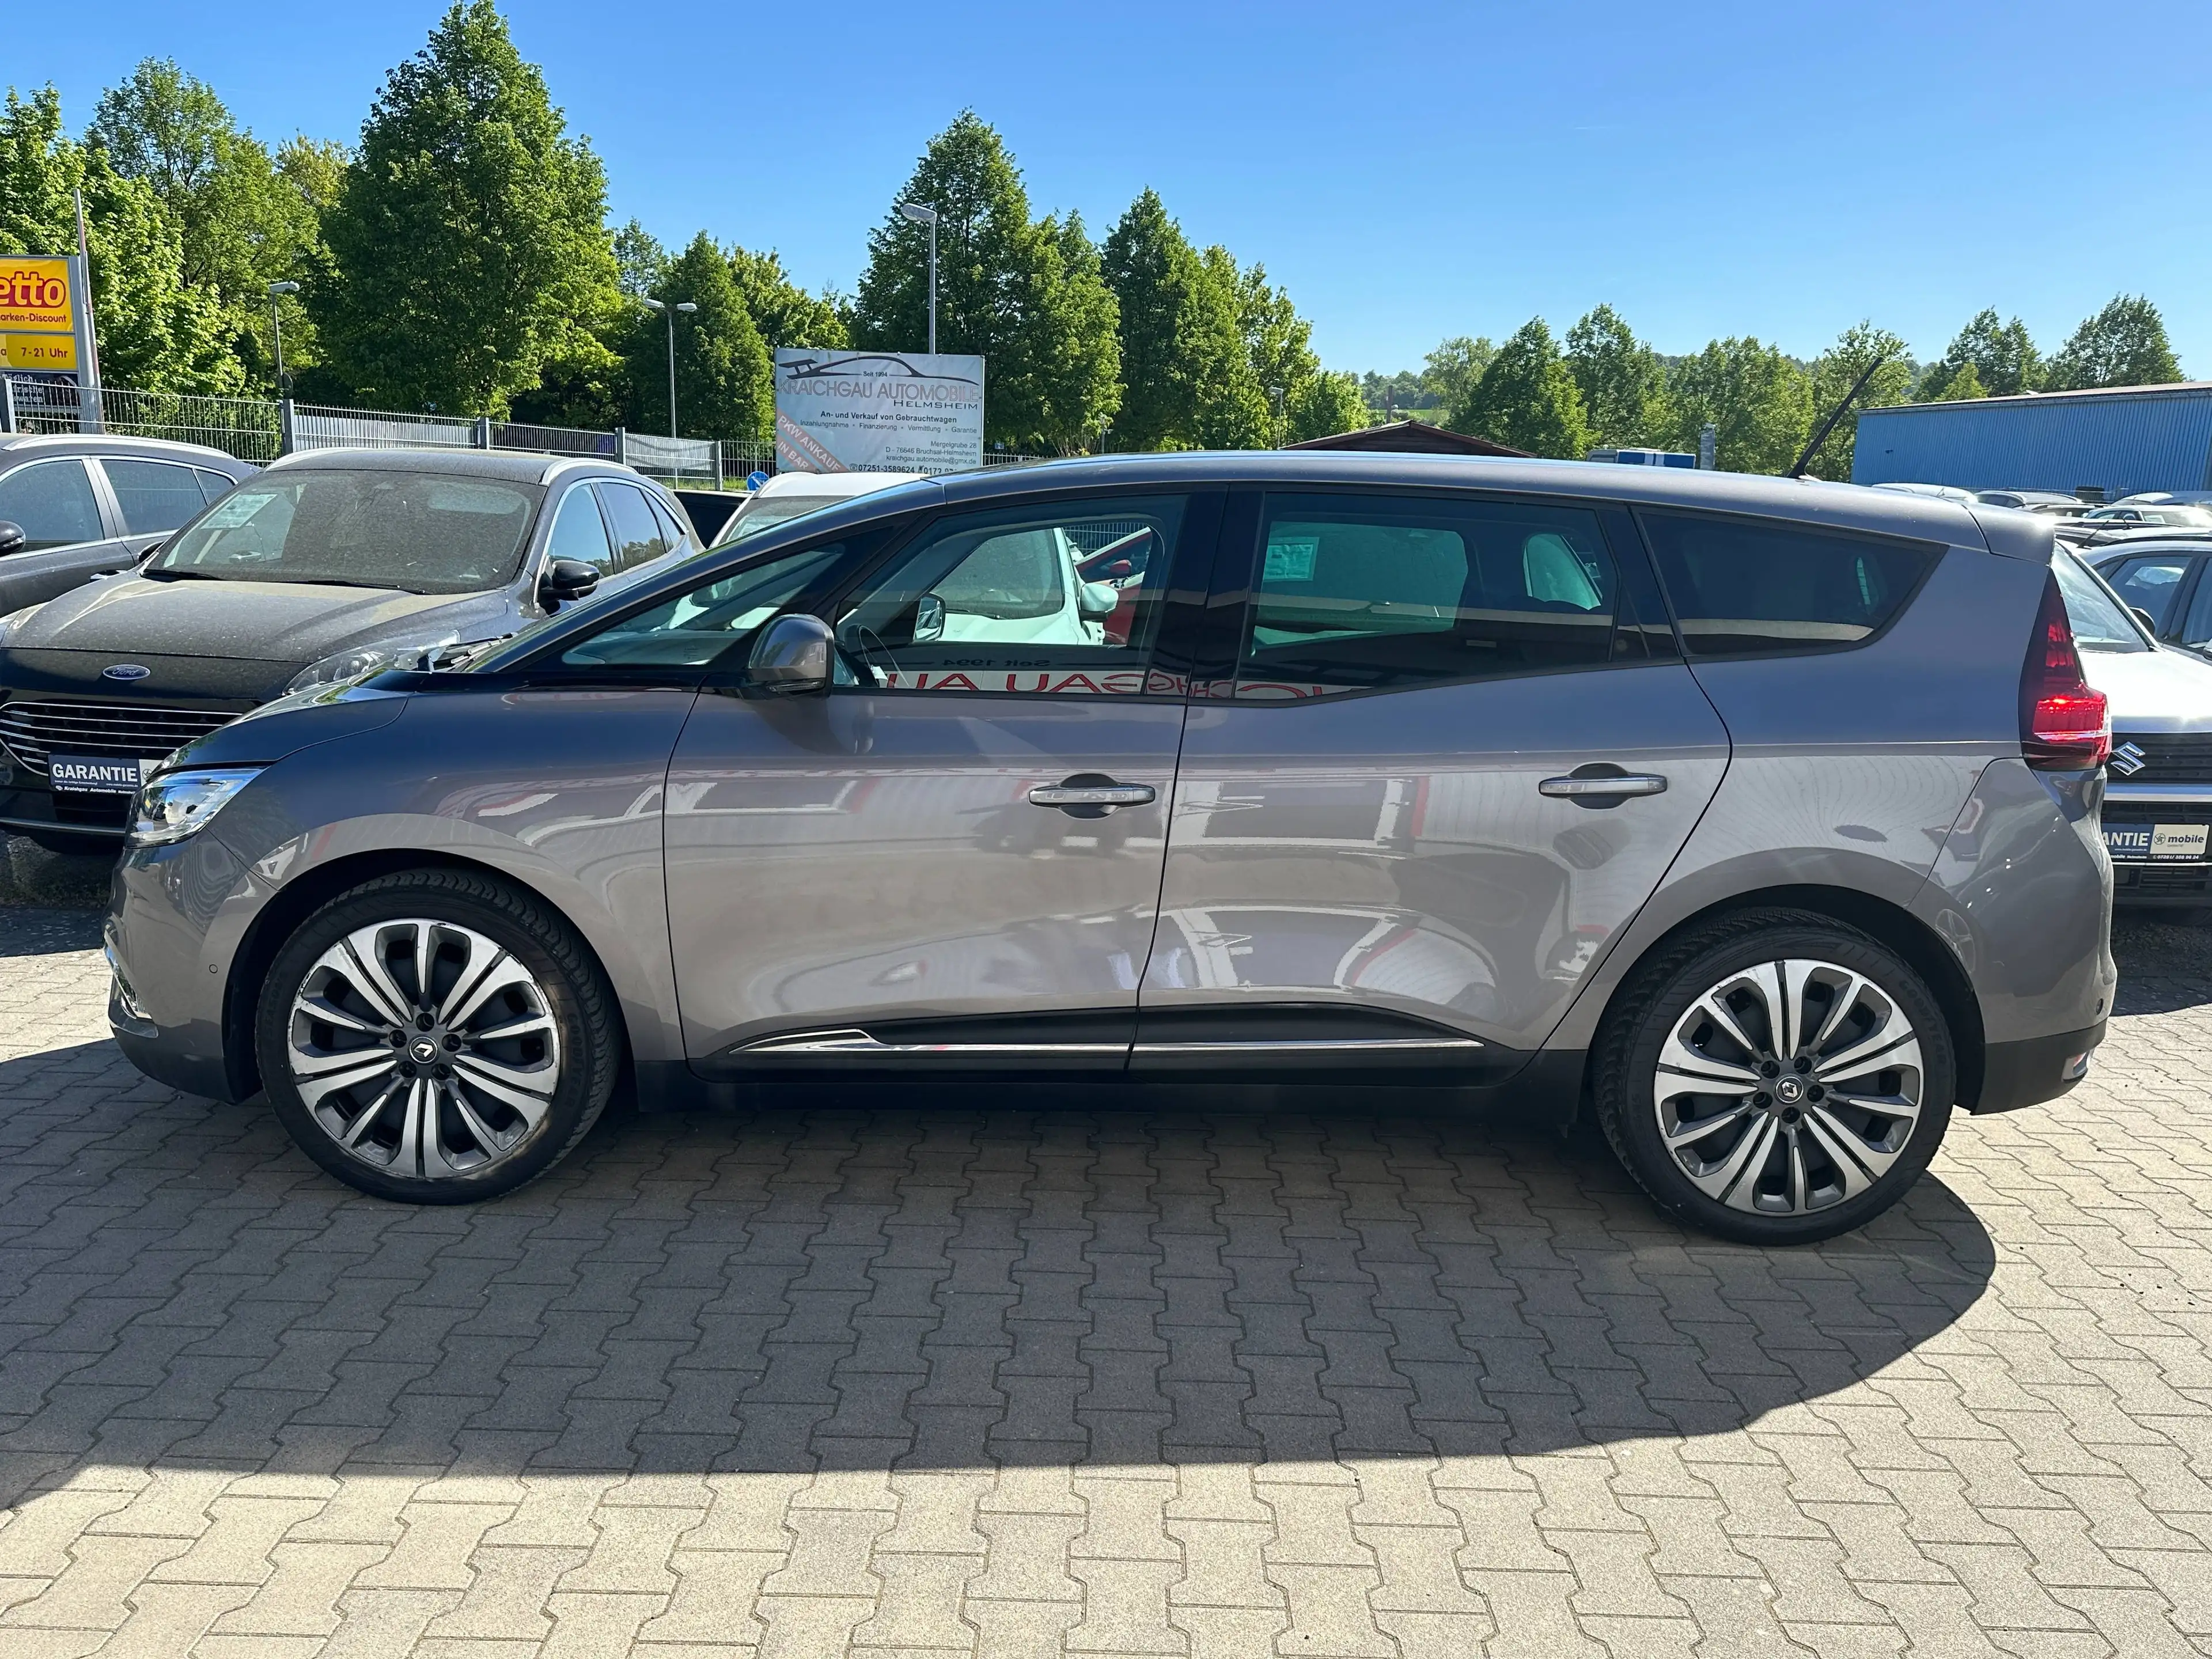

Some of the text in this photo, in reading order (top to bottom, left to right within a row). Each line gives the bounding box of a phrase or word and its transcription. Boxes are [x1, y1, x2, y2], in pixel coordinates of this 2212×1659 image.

[0, 313, 66, 323] arken-Discount
[49, 348, 68, 358] Uhr
[778, 378, 979, 402] KRAICHGAU AUTOMOBILE
[893, 400, 978, 410] HELMSHEIM
[896, 414, 957, 423] Gebrauchtwagen
[859, 423, 897, 431] Finanzierung
[778, 415, 841, 471] PKW ANKAUF
[930, 441, 968, 449] Mergelgrube
[778, 441, 809, 469] IN BAR
[858, 464, 915, 473] 07251-3589624
[112, 667, 140, 676] Ford
[52, 763, 138, 782] GARANTIE
[2168, 834, 2205, 843] mobile
[1899, 980, 1947, 1065] GOODYEAR
[564, 1013, 584, 1107] GOODYEAR
